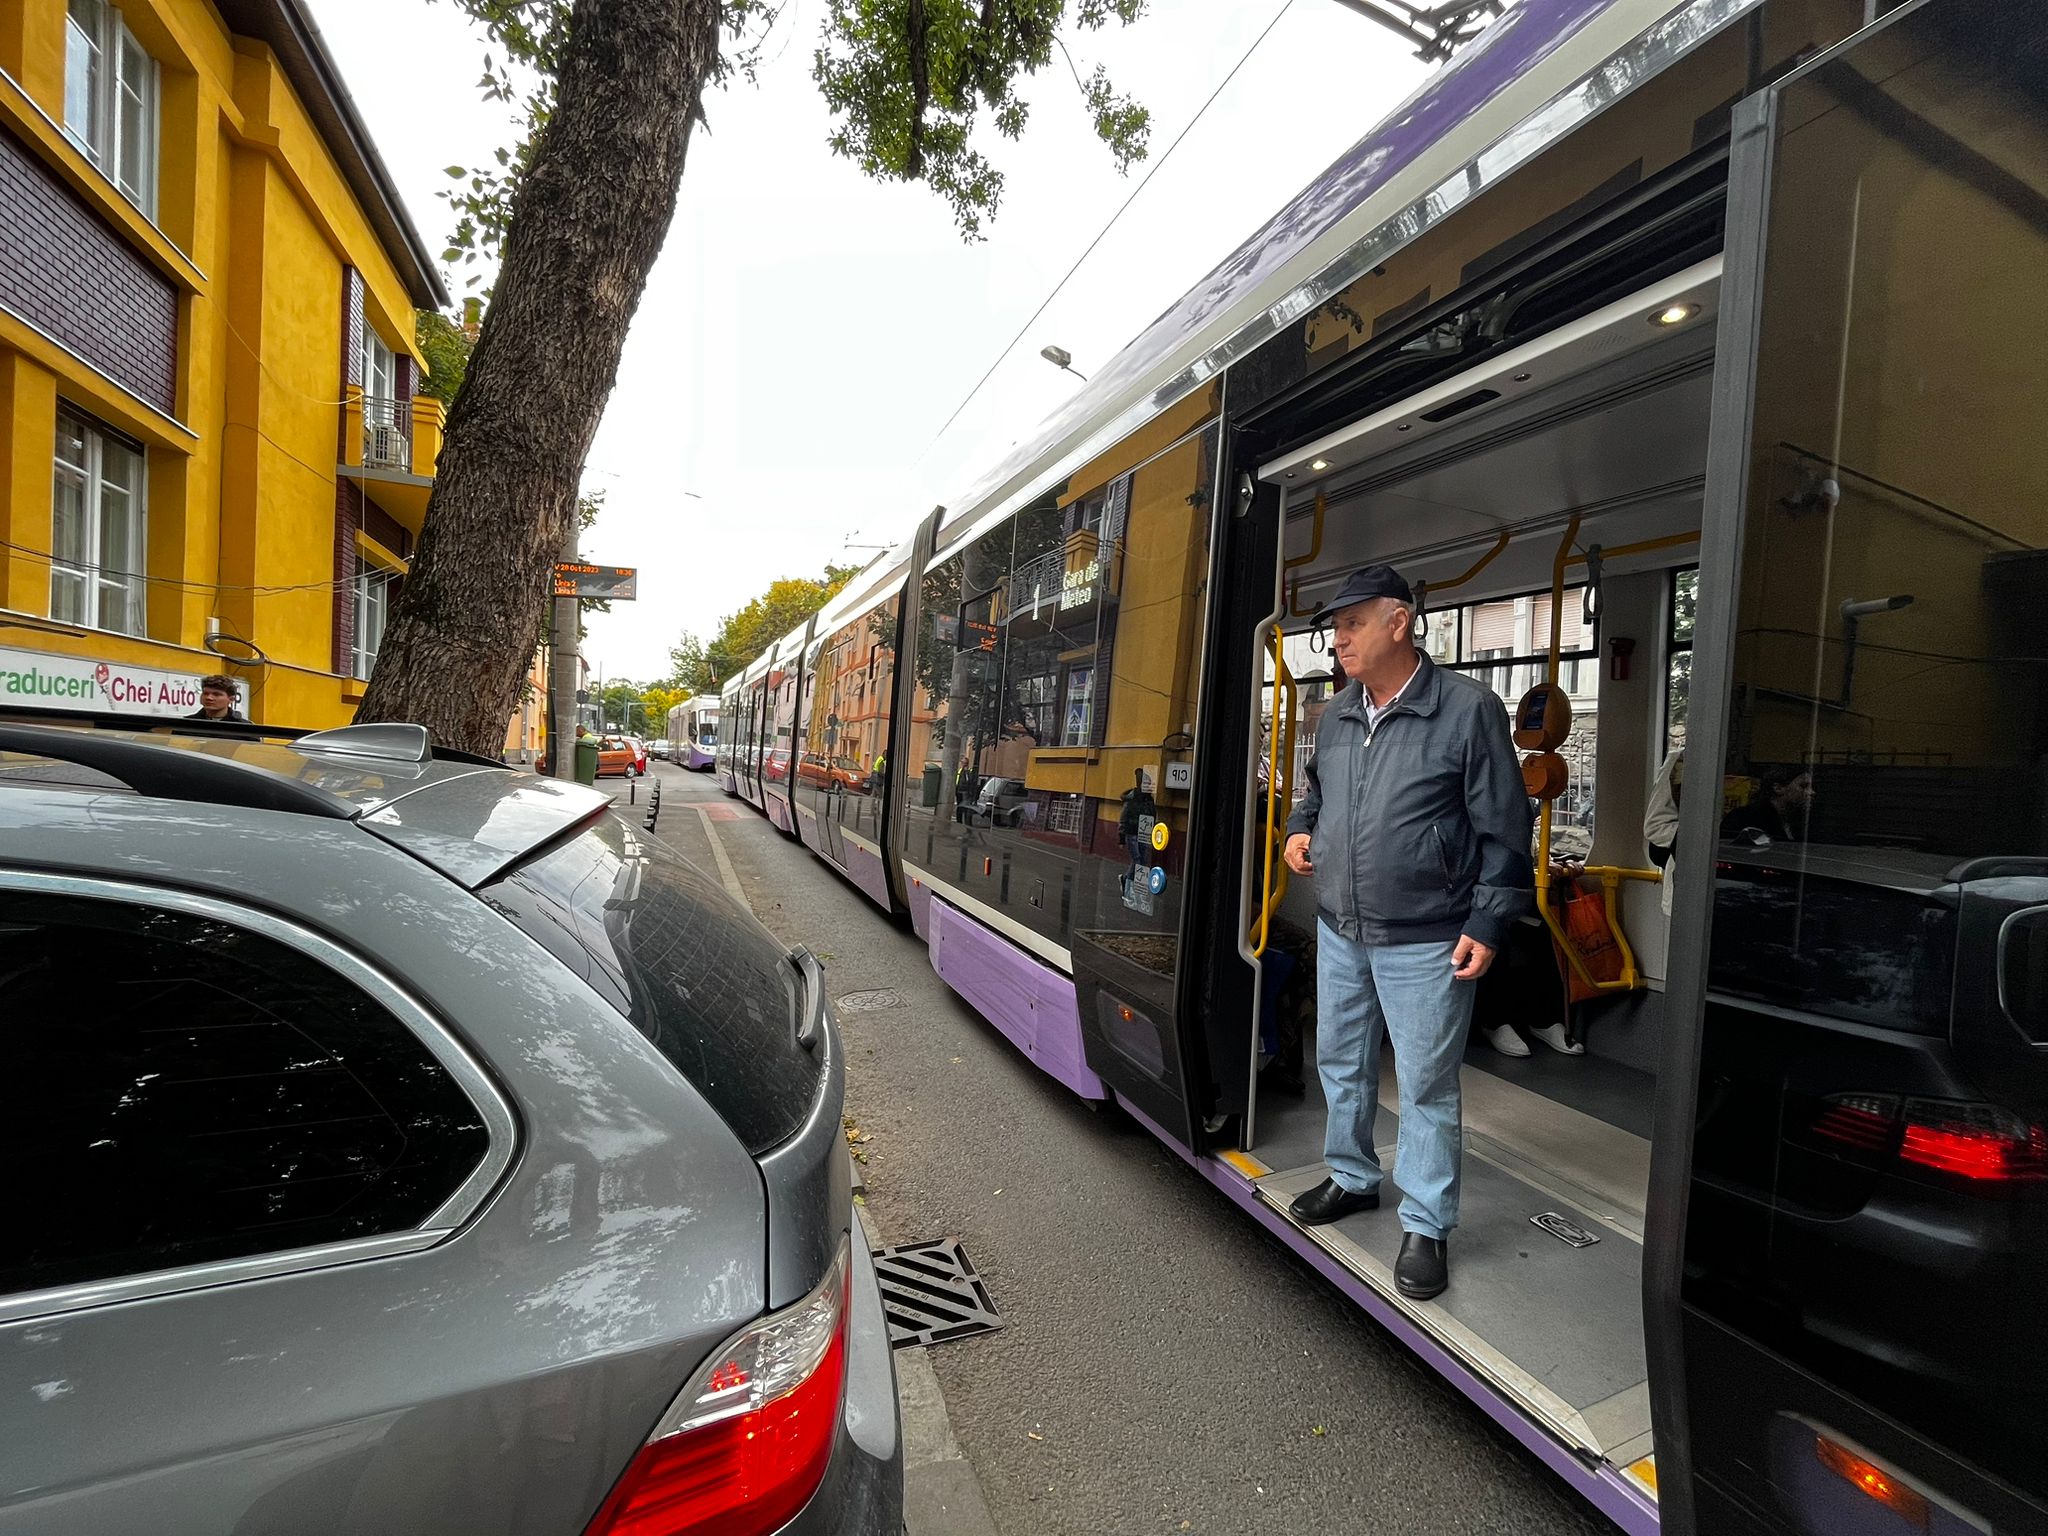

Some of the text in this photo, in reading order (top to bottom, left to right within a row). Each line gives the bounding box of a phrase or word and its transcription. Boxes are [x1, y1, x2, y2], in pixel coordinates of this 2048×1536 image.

[1062, 560, 1099, 591] Gara de
[1032, 583, 1041, 621] 1
[1060, 586, 1092, 612] Meteo
[111, 677, 196, 707] Chei Auto
